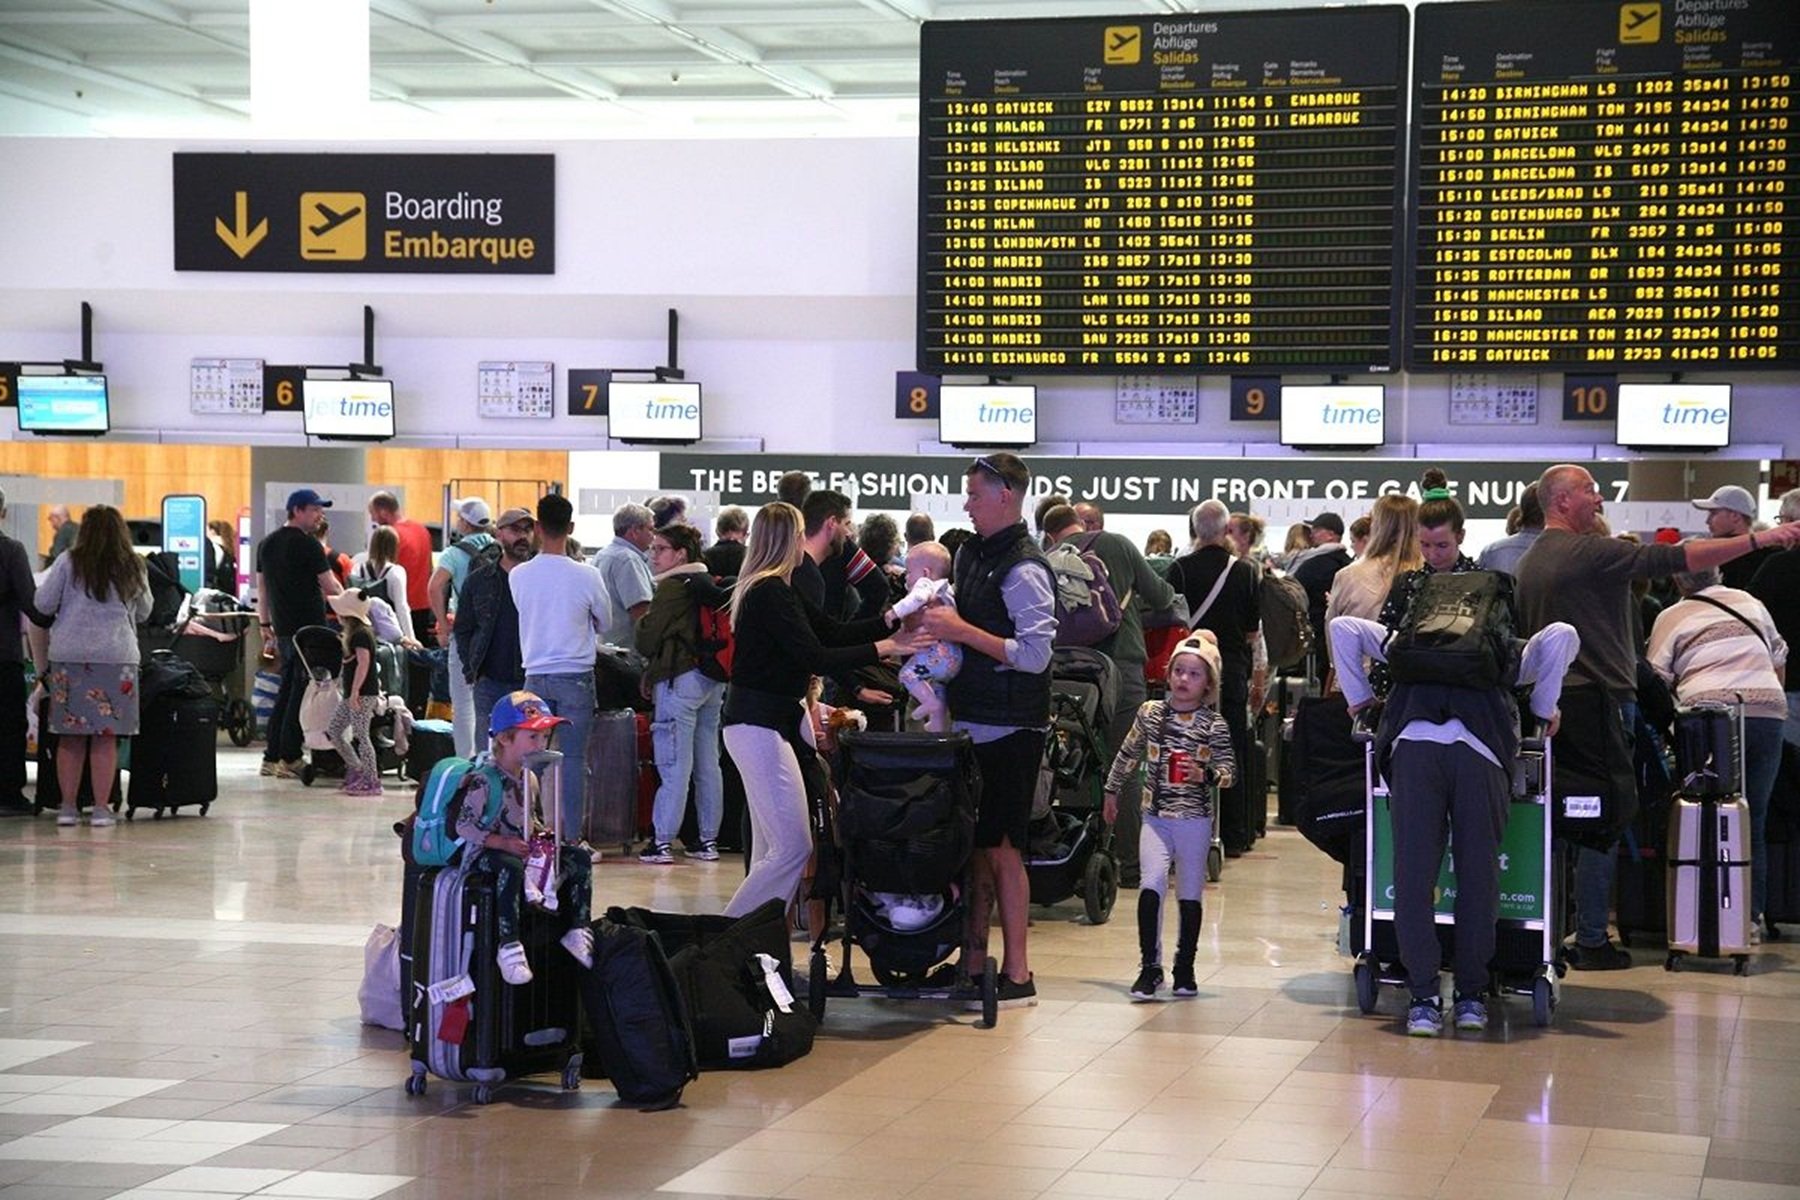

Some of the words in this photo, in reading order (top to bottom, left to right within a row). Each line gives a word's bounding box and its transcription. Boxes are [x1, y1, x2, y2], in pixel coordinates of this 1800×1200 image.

[1153, 20, 1218, 36] Departures
[1674, 13, 1727, 28] Abflüge
[1152, 35, 1198, 50] Abflüge
[1674, 29, 1728, 45] Salidas
[1152, 51, 1199, 65] Salidas
[1442, 87, 1487, 102] 14:20
[1495, 84, 1589, 100] BIRMINGHAM
[1742, 75, 1790, 89] 13:50
[947, 102, 988, 116] 12:40
[995, 101, 1054, 115] GATWICK
[1213, 95, 1256, 109] 11:54
[1441, 107, 1486, 122] 14:50
[1494, 104, 1588, 121] BIRMINGHAM
[1741, 96, 1789, 110] 14:20
[947, 120, 988, 134] 12:45
[1213, 114, 1256, 129] 12:00
[1440, 128, 1486, 143] 15:00
[1493, 126, 1559, 141] GATWICK
[1740, 117, 1788, 131] 14:30
[946, 141, 988, 154] 13:25
[994, 140, 1061, 154] HELSINKI
[1212, 135, 1256, 149] 12:55
[1439, 148, 1484, 163] 15:00
[1492, 145, 1576, 161] BARCELONA
[1739, 138, 1787, 152] 14:30
[946, 160, 987, 173] 13:25
[995, 159, 1045, 173] BILBAO
[1212, 155, 1255, 169] 12:55
[1439, 168, 1484, 183] 15:00
[1492, 166, 1576, 182] BARCELONA
[1738, 158, 1786, 173] 14:30
[946, 179, 987, 192] 13:25
[994, 178, 1044, 192] BILBAO
[1211, 174, 1254, 188] 12:55
[1438, 189, 1483, 203] 15:10
[1491, 186, 1584, 202] LEEDS/BRAD
[1737, 180, 1785, 194] 14:40
[385, 191, 502, 226] Boarding
[946, 198, 987, 212] 13:35
[992, 197, 1077, 211] COPENHAGUE
[1211, 194, 1254, 208] 13:05
[1437, 209, 1482, 223] 15:20
[1736, 201, 1784, 215] 14:50
[945, 218, 986, 231] 13:45
[993, 217, 1036, 231] MILAN
[1211, 213, 1254, 227] 13:15
[1436, 228, 1482, 243] 15:30
[1490, 227, 1546, 242] BERLIN
[1735, 221, 1783, 236] 15:00
[383, 229, 535, 264] Embarque
[945, 236, 986, 250] 13:55
[993, 236, 1077, 250] LONDON/STN
[1210, 233, 1253, 247] 13:25
[945, 255, 986, 268] 14:00
[993, 255, 1043, 268] MADRID
[1210, 252, 1253, 266] 13:30
[1436, 249, 1481, 263] 15:35
[1488, 247, 1573, 262] ESTOCOLMO
[1734, 242, 1782, 256] 15:05
[944, 275, 985, 288] 14:00
[992, 275, 1043, 288] MADRID
[1209, 273, 1252, 286] 13:30
[1435, 269, 1480, 283] 15:35
[1488, 267, 1572, 282] ROTTERDAM
[1733, 263, 1781, 277] 15:05
[944, 294, 985, 307] 14:00
[992, 294, 1042, 307] MADRID
[1209, 292, 1252, 306] 13:30
[1434, 289, 1480, 303] 15:45
[1487, 287, 1580, 302] MANCHESTER
[1732, 283, 1780, 298] 15:15
[944, 314, 985, 326] 14:00
[992, 314, 1042, 326] MADRID
[1209, 312, 1251, 325] 13:30
[1434, 308, 1479, 322] 15:50
[1487, 308, 1543, 322] BILBAO
[1731, 304, 1780, 318] 15:20
[944, 332, 985, 345] 14:00
[992, 332, 1042, 345] MADRID
[1208, 331, 1251, 345] 13:30
[1433, 329, 1479, 342] 16:30
[1486, 328, 1579, 342] MANCHESTER
[1730, 325, 1779, 339] 16:00
[944, 351, 985, 364] 14:10
[991, 351, 1066, 364] EDINBURGO
[1208, 351, 1251, 364] 13:45
[1433, 348, 1478, 362] 16:35
[1485, 348, 1550, 362] GATWICK
[1729, 345, 1777, 359] 16:05
[276, 380, 294, 406] 6
[581, 384, 598, 409] 7
[909, 387, 928, 413] 8
[1245, 387, 1265, 414] 9
[1571, 387, 1608, 414] 10
[645, 398, 698, 421] time
[978, 401, 1034, 424] time
[1322, 401, 1382, 426] time
[1661, 402, 1728, 425] time
[690, 469, 743, 492] THE
[752, 470, 820, 494] BET
[830, 471, 949, 496] FASHION
[1082, 476, 1161, 500] JUST
[1172, 478, 1199, 502] IN
[1212, 478, 1315, 501] FRONT
[1325, 479, 1369, 500] OF
[1611, 480, 1631, 503] 7
